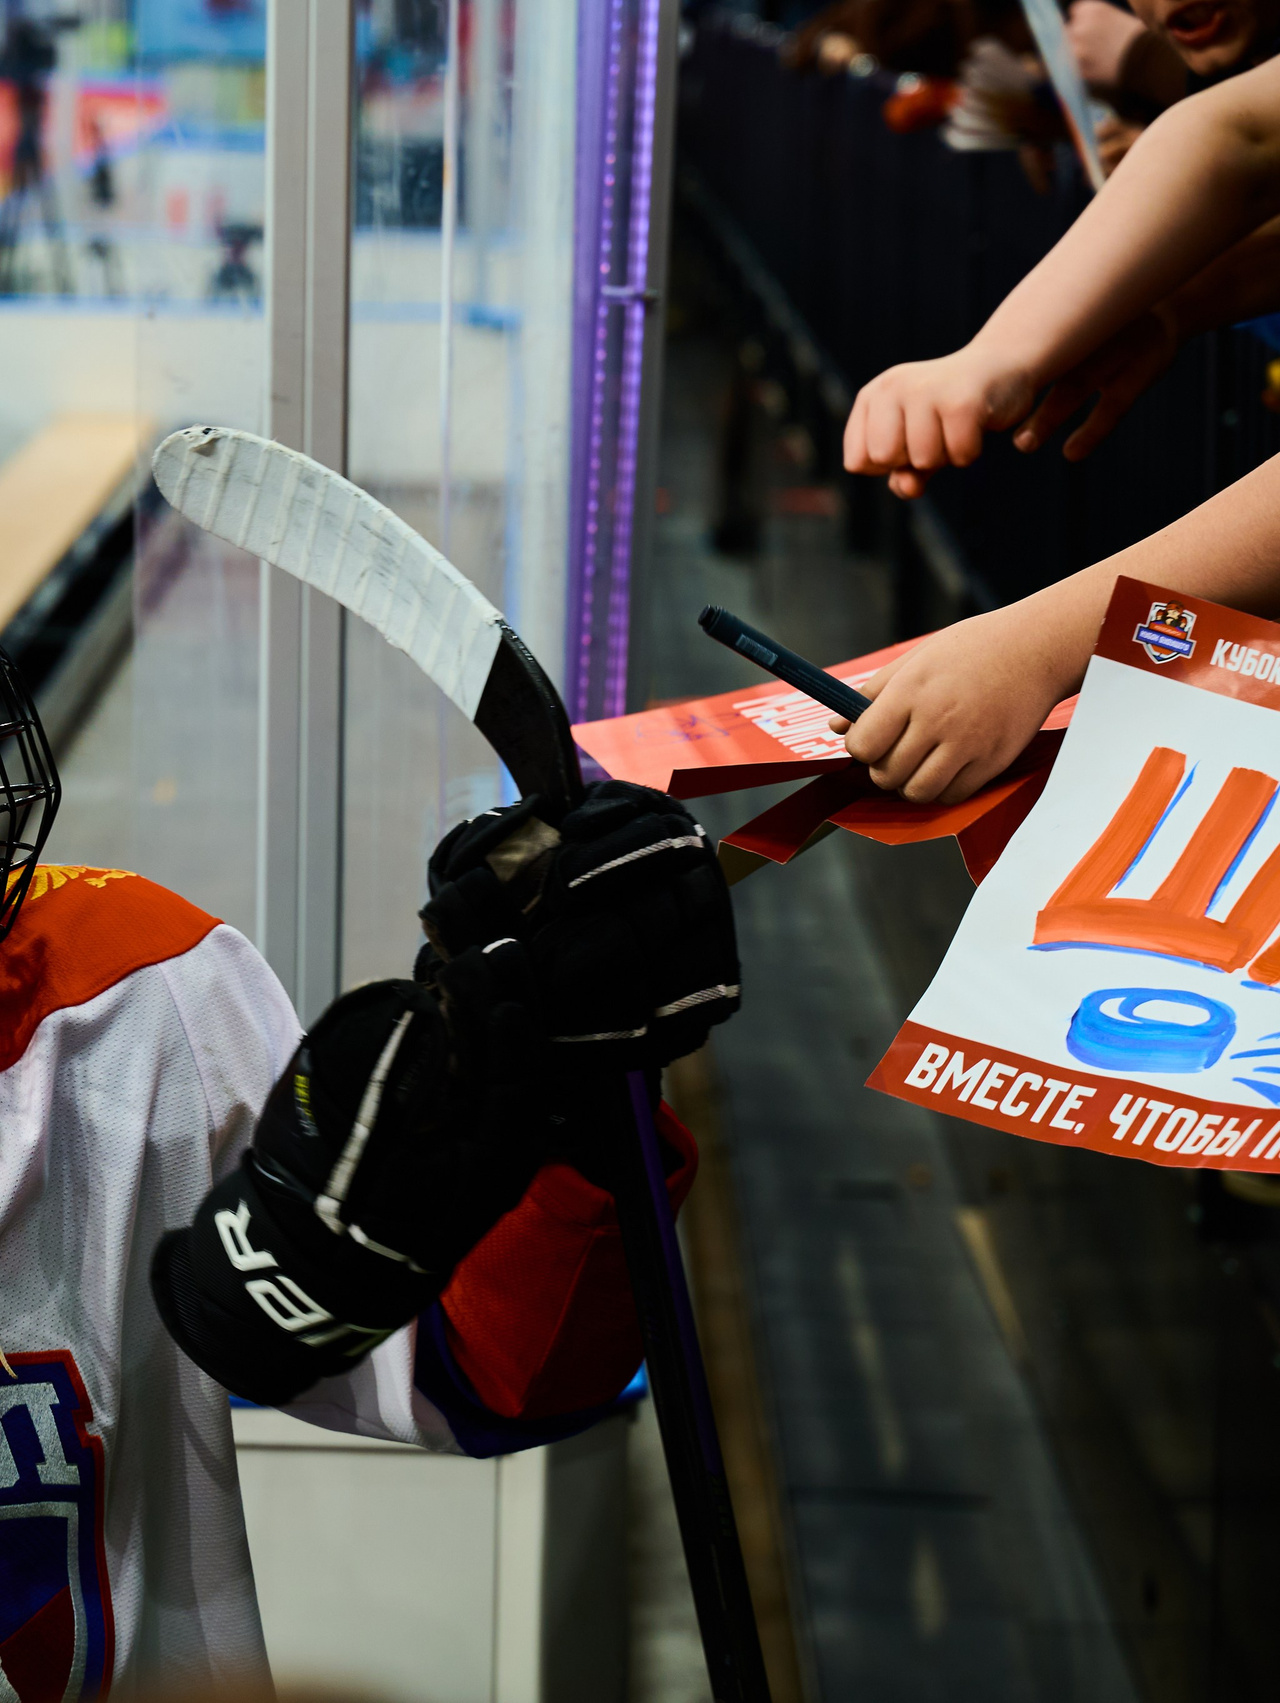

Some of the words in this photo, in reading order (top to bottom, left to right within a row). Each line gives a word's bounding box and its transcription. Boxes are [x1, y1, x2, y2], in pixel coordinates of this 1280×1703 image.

[1028, 745, 1280, 988] Ш
[904, 1042, 1098, 1135] ВМЕСТЕ,
[1109, 1093, 1263, 1158] ЧТОБЫ
